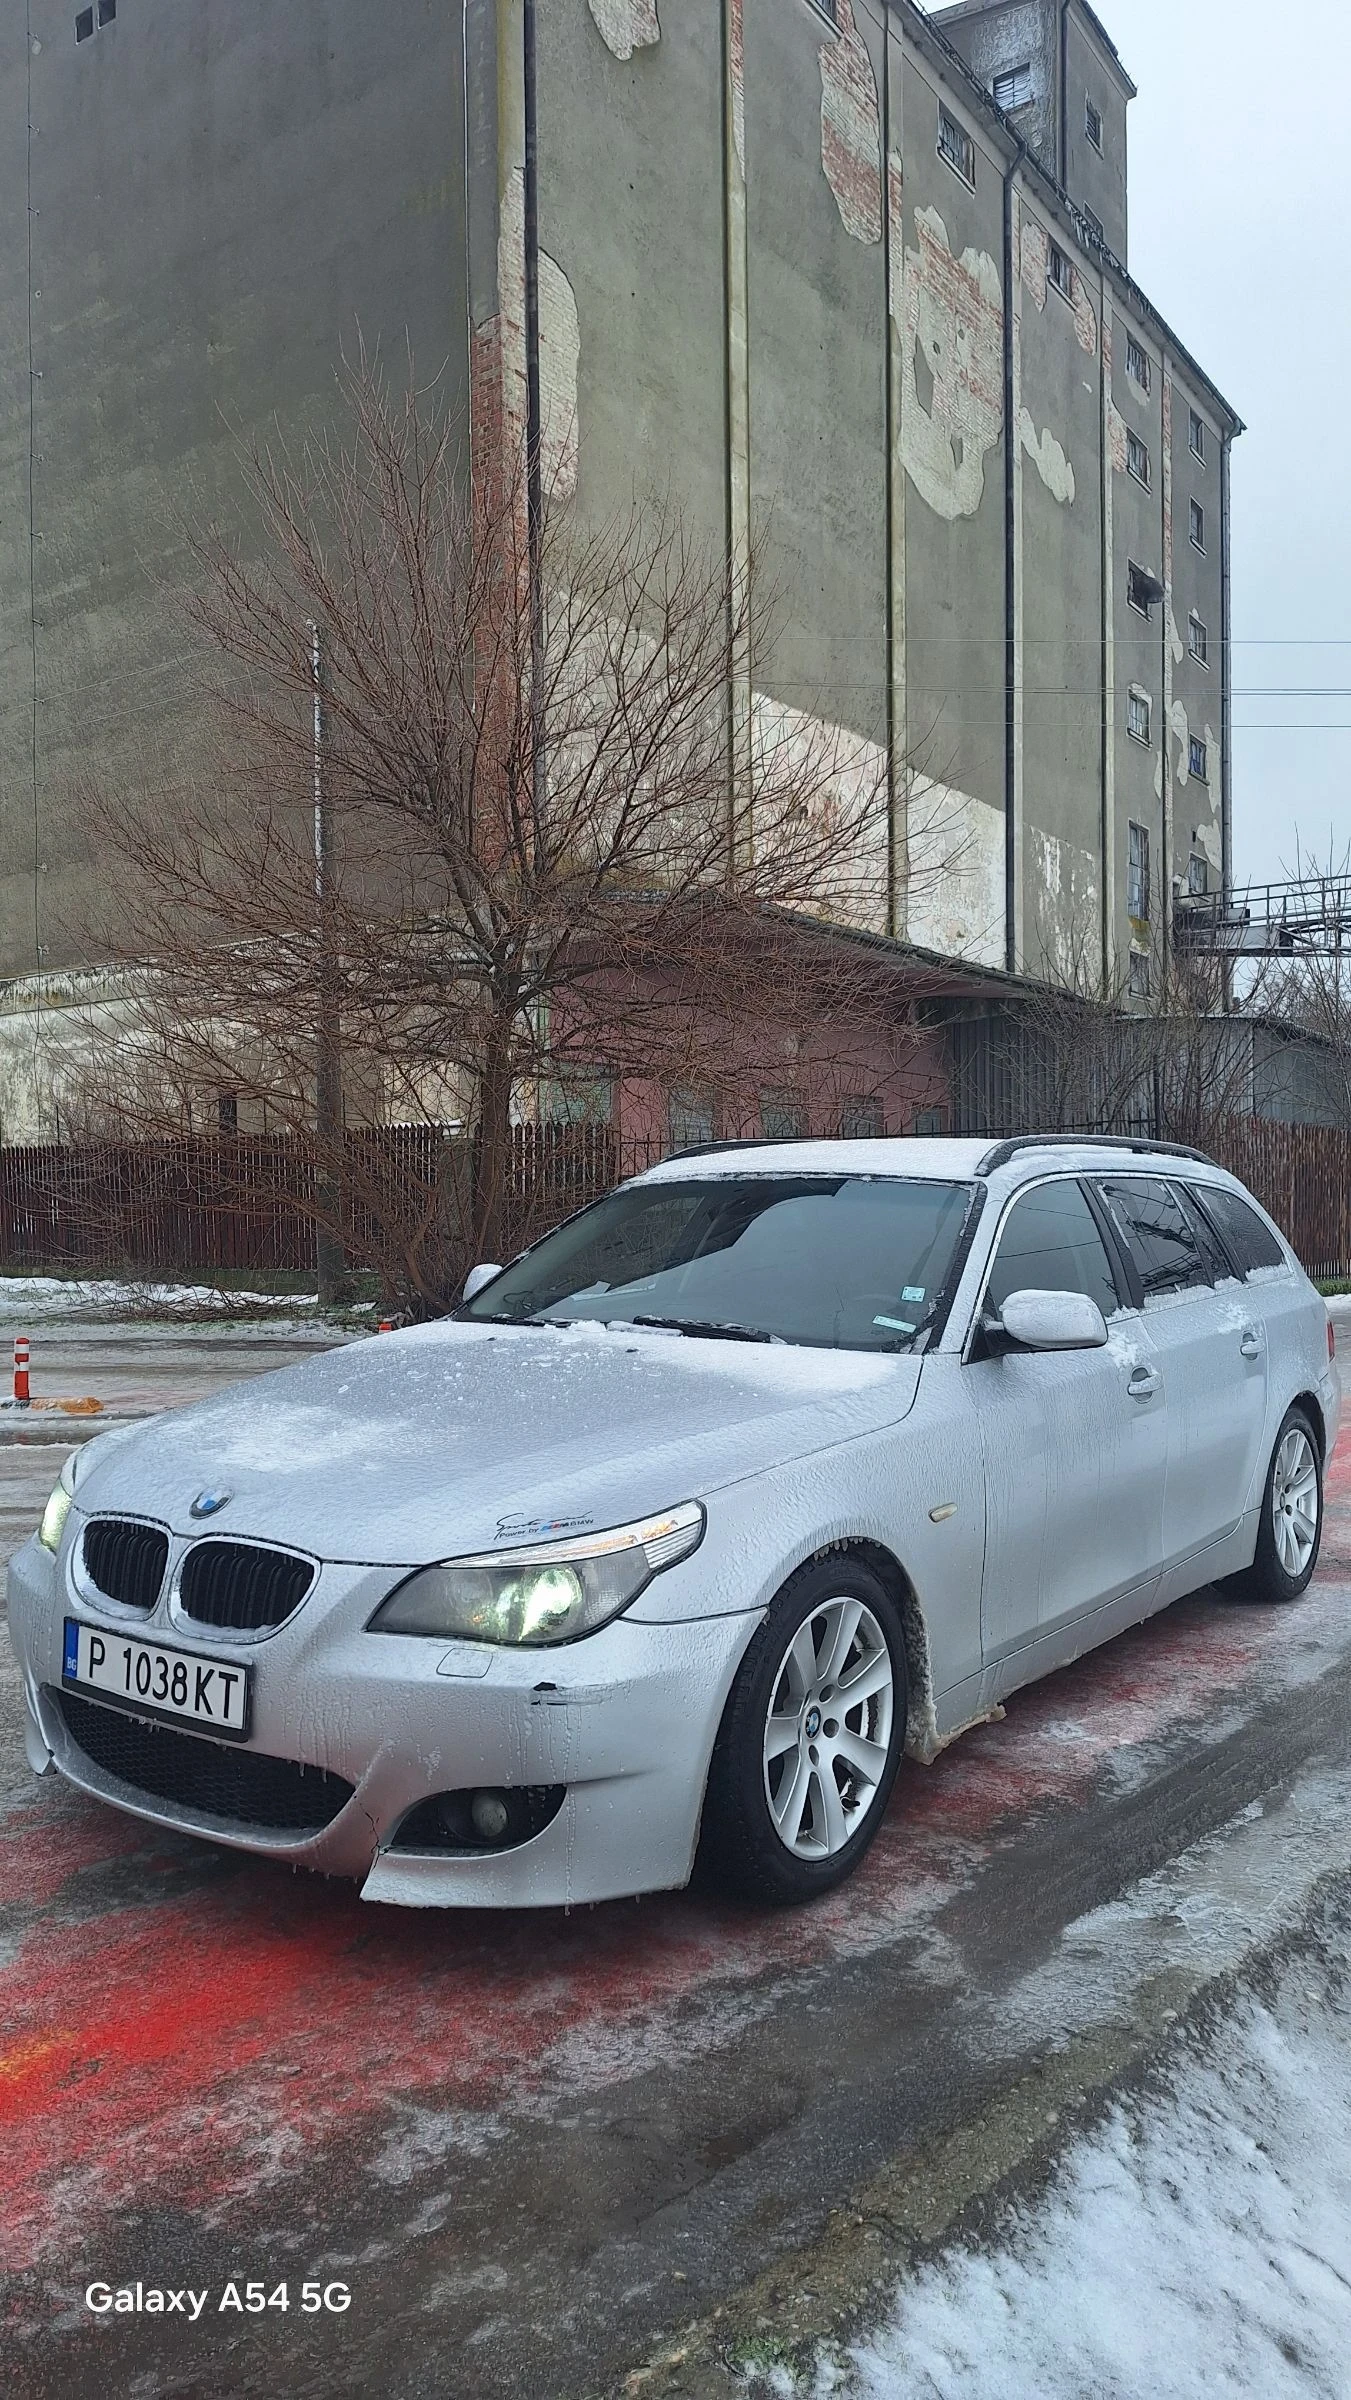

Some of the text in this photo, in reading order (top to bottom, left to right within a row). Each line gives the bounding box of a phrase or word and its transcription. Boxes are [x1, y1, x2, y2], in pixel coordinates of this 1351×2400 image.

[499, 1529, 526, 1539] Power
[66, 1656, 77, 1671] BG
[89, 1636, 106, 1679] P
